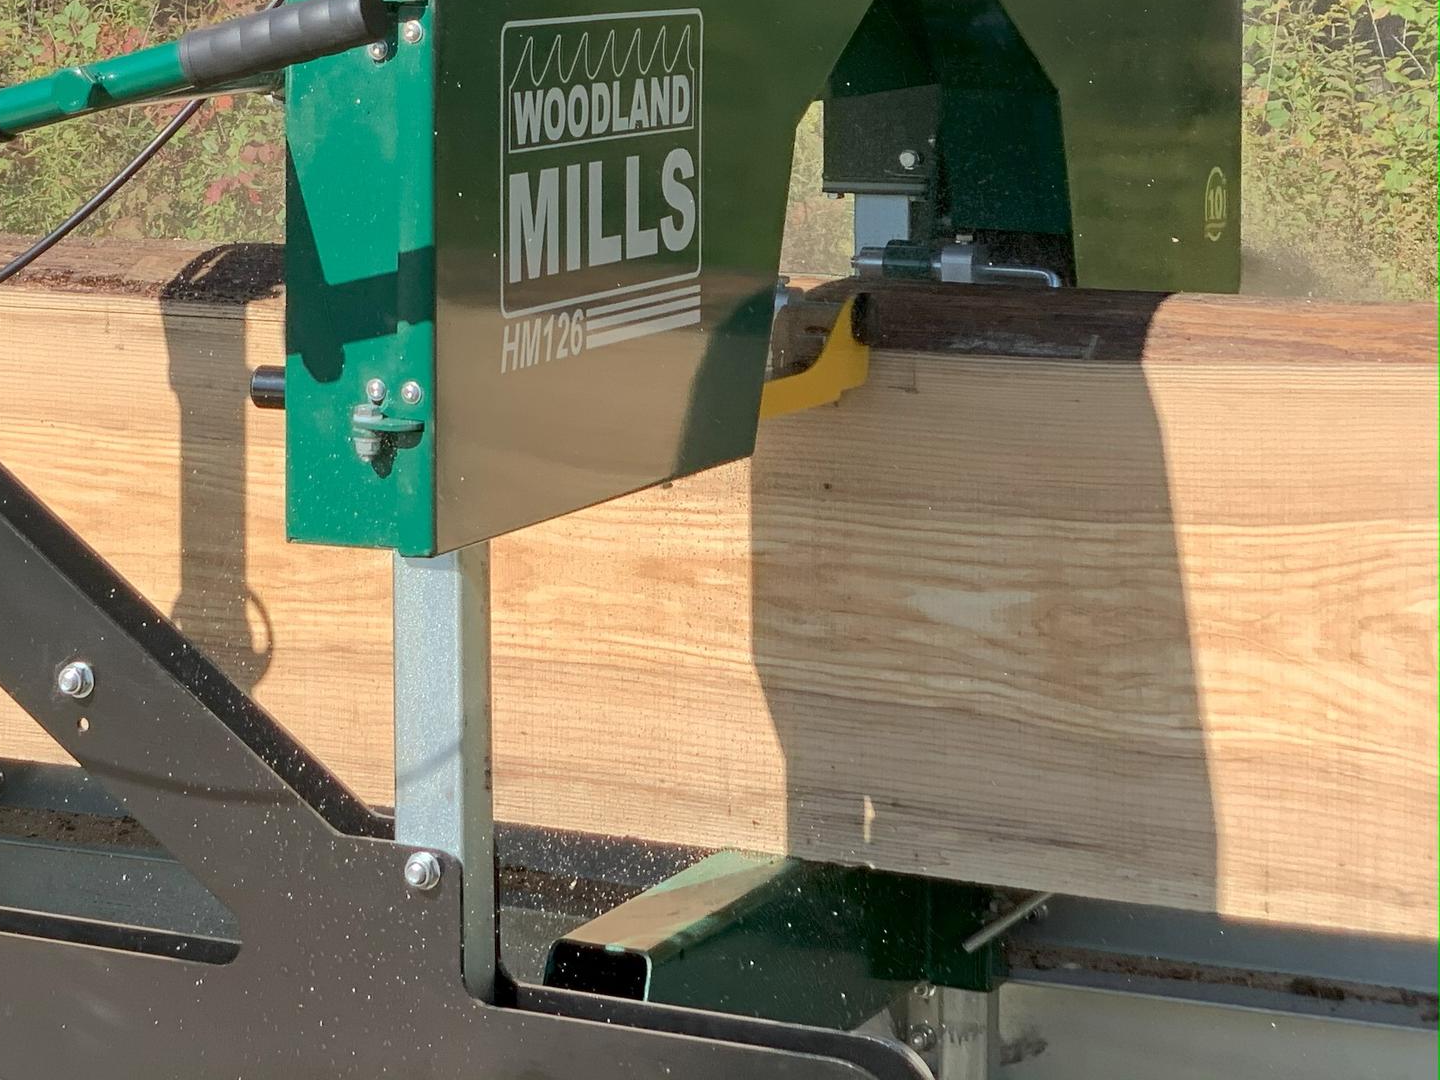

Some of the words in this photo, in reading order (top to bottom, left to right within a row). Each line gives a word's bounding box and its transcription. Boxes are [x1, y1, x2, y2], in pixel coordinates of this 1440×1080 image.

[513, 74, 691, 145] WOODLAND
[509, 148, 696, 284] MILLS
[500, 308, 584, 374] HM126
